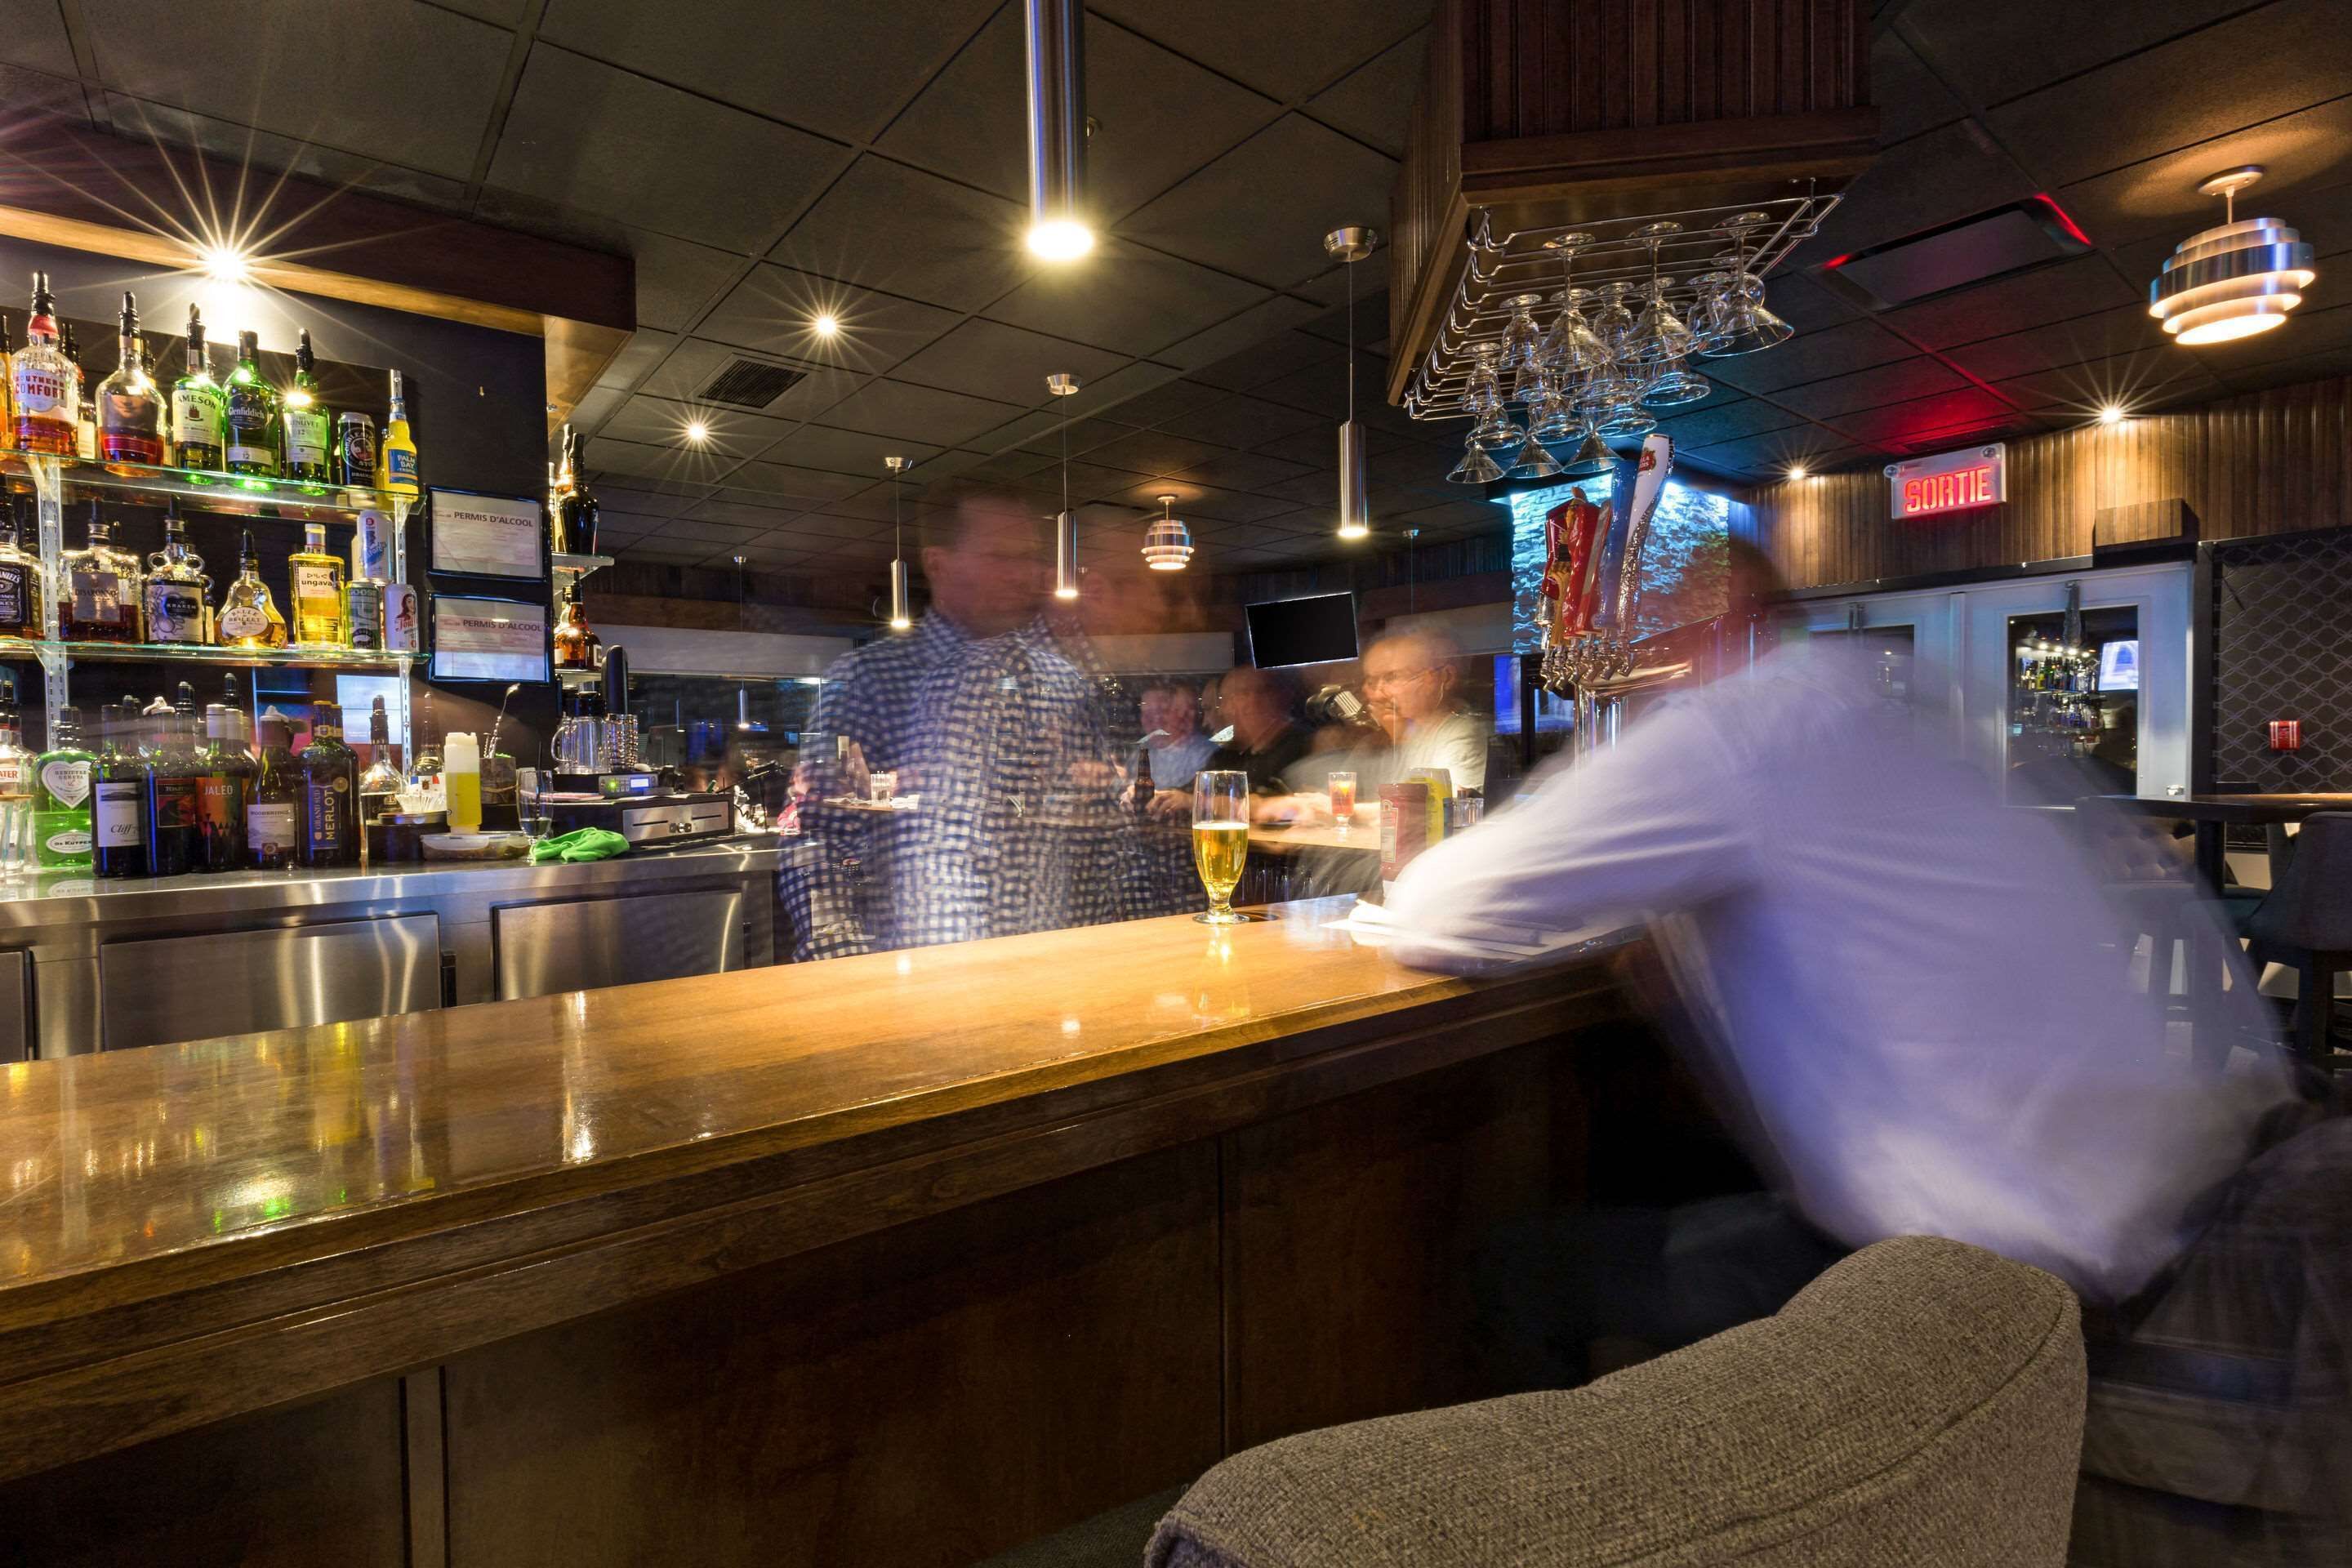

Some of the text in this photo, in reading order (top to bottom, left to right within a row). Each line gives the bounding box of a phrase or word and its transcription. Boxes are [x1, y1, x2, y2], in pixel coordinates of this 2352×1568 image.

[14, 375, 65, 387] SOUTHERN
[14, 384, 65, 399] COMFORT
[176, 394, 216, 409] AMESON
[228, 406, 265, 419] Glenfiddich
[400, 461, 415, 470] BAY
[1905, 466, 1993, 514] SORTIE
[454, 511, 488, 522] PERMIS
[489, 515, 533, 528] D'ALCOOL
[301, 579, 332, 587] ungava
[463, 619, 497, 629] PERMIS
[498, 621, 542, 632] D'ALCOOL
[0, 770, 19, 778] ATER
[204, 785, 233, 795] JALEO
[324, 789, 335, 840] MERLOT
[110, 823, 132, 835] Cliff
